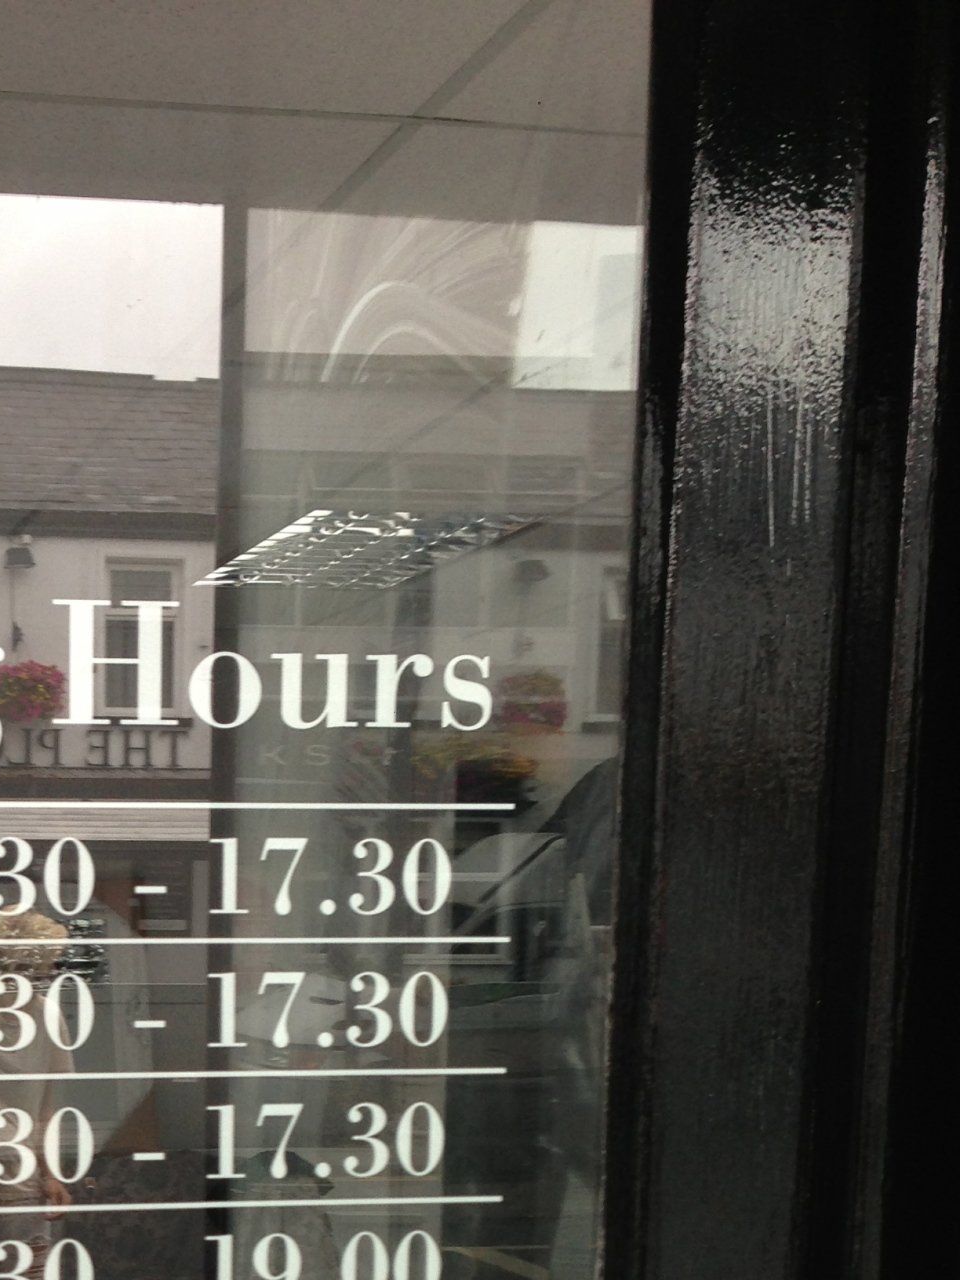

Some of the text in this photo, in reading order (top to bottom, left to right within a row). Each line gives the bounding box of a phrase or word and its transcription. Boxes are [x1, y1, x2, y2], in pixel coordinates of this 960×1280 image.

[51, 598, 493, 731] Hours
[135, 885, 167, 894] -
[210, 838, 452, 915] 17.30
[134, 1020, 166, 1029] -
[208, 971, 447, 1048] 17.30
[134, 1152, 165, 1161] -
[207, 1102, 443, 1178] 17.30
